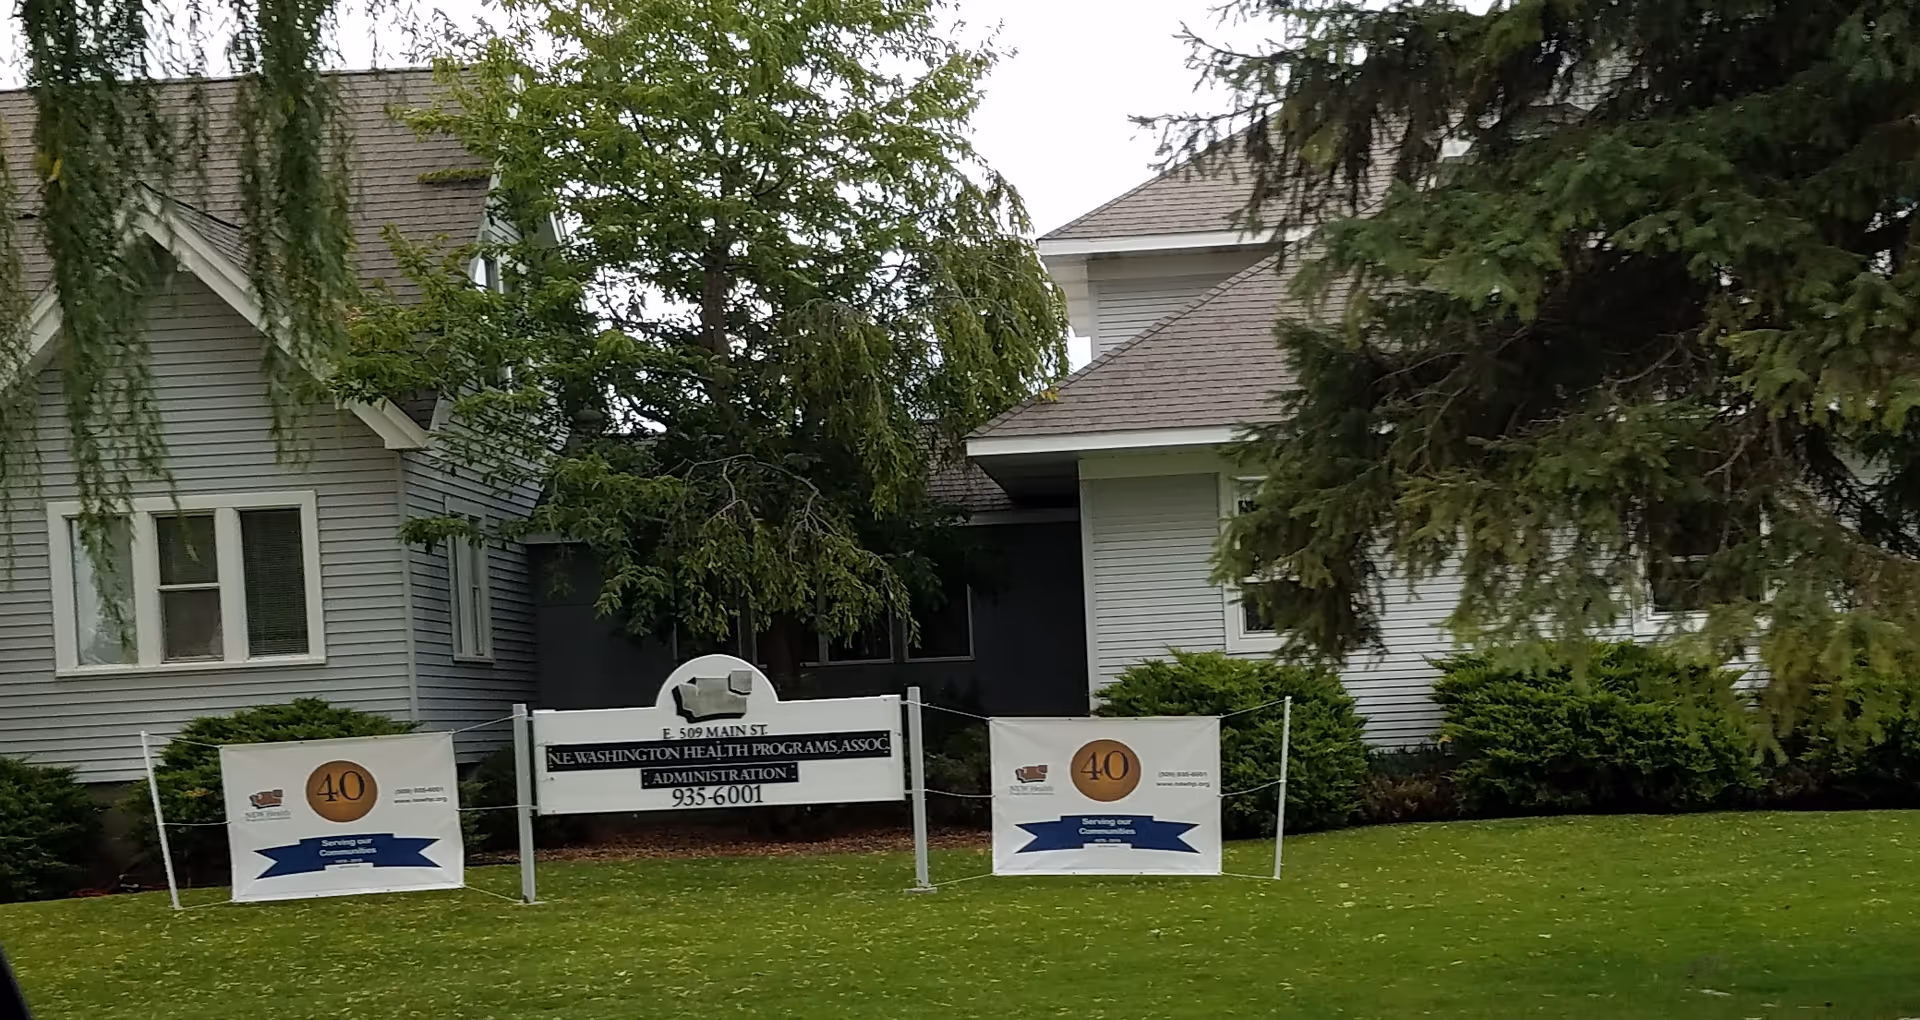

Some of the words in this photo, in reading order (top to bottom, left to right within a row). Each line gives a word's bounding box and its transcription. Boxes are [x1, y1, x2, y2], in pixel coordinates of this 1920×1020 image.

[663, 728, 675, 740] E.
[680, 727, 703, 739] 509
[706, 725, 747, 738] MAIN
[750, 724, 768, 736] ST.
[575, 747, 681, 764] WASHINGTON
[684, 744, 748, 759] HEALTH
[1080, 750, 1129, 781] 40
[652, 767, 788, 784] ADMINISTRATION
[317, 770, 365, 802] 40
[672, 785, 764, 807] 935-6001
[1081, 818, 1116, 827] Serving
[1078, 827, 1137, 835] Communities
[321, 839, 356, 847] Serving
[318, 847, 378, 857] Communities
